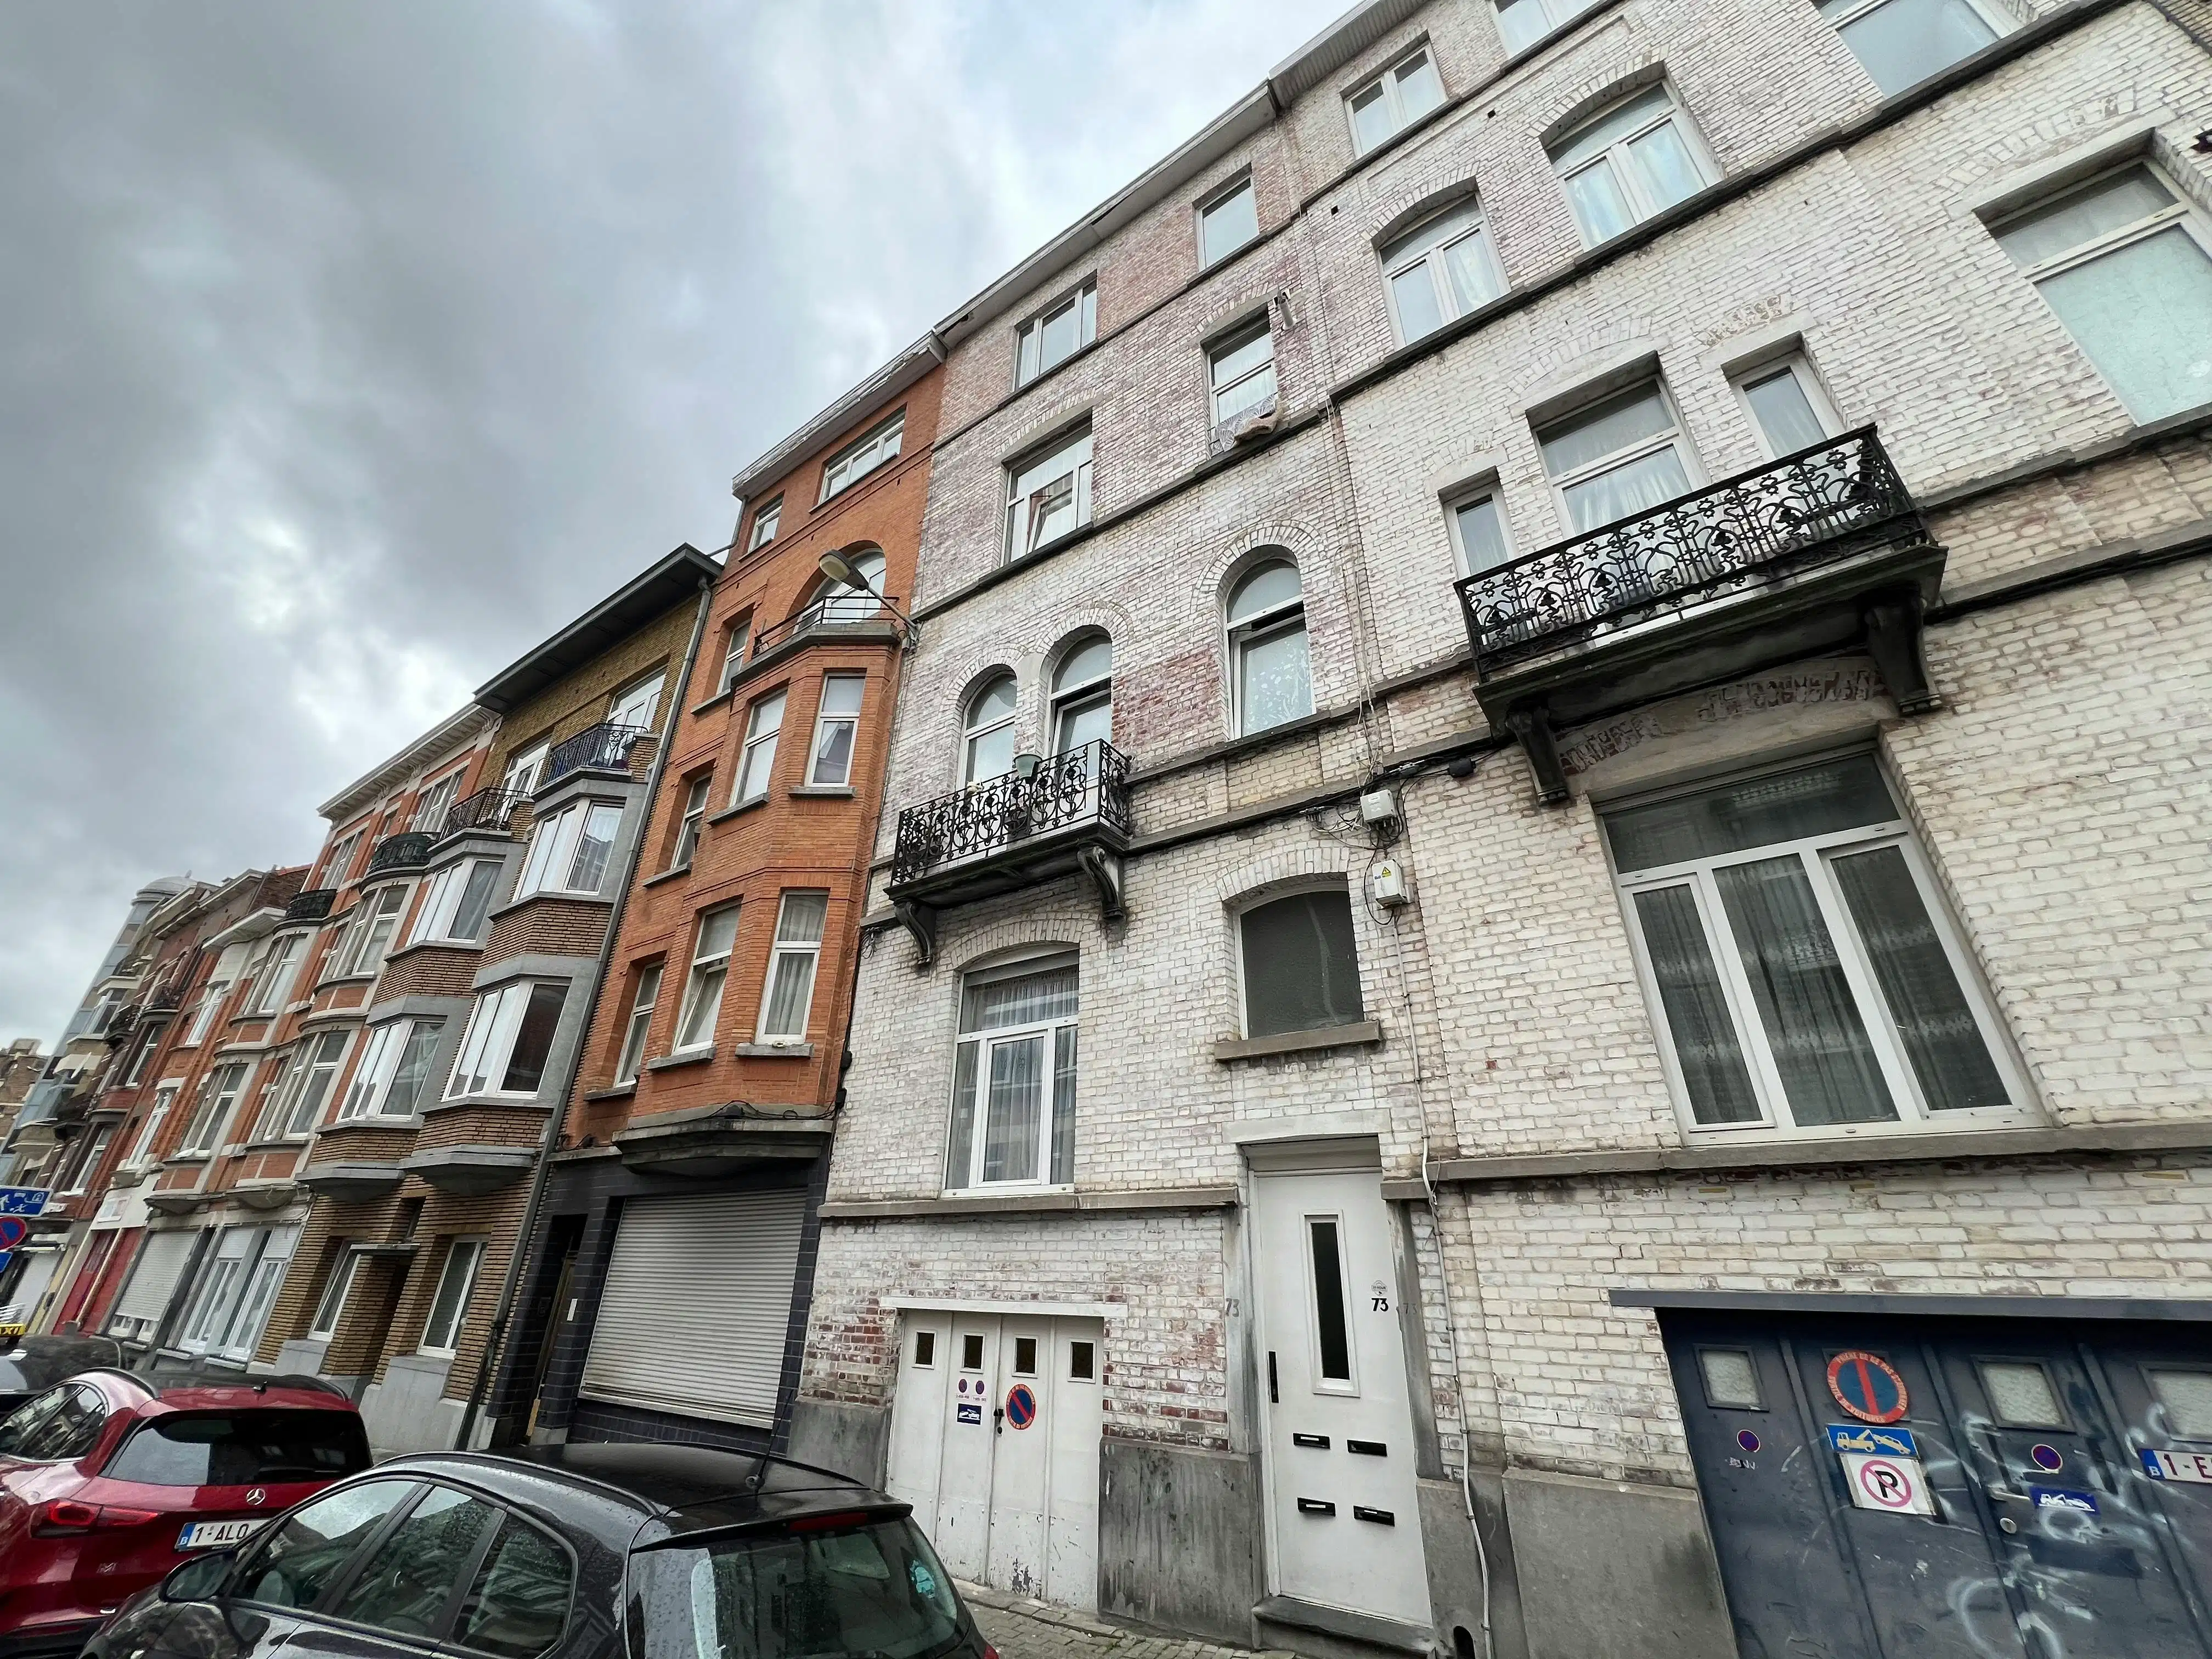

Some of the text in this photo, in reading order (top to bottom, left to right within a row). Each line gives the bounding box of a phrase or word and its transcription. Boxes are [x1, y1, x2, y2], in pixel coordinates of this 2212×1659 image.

[1372, 1297, 1389, 1312] 73
[1403, 1303, 1418, 1315] 73
[2148, 1453, 2212, 1479] B 1-E
[1875, 1470, 1898, 1498] P
